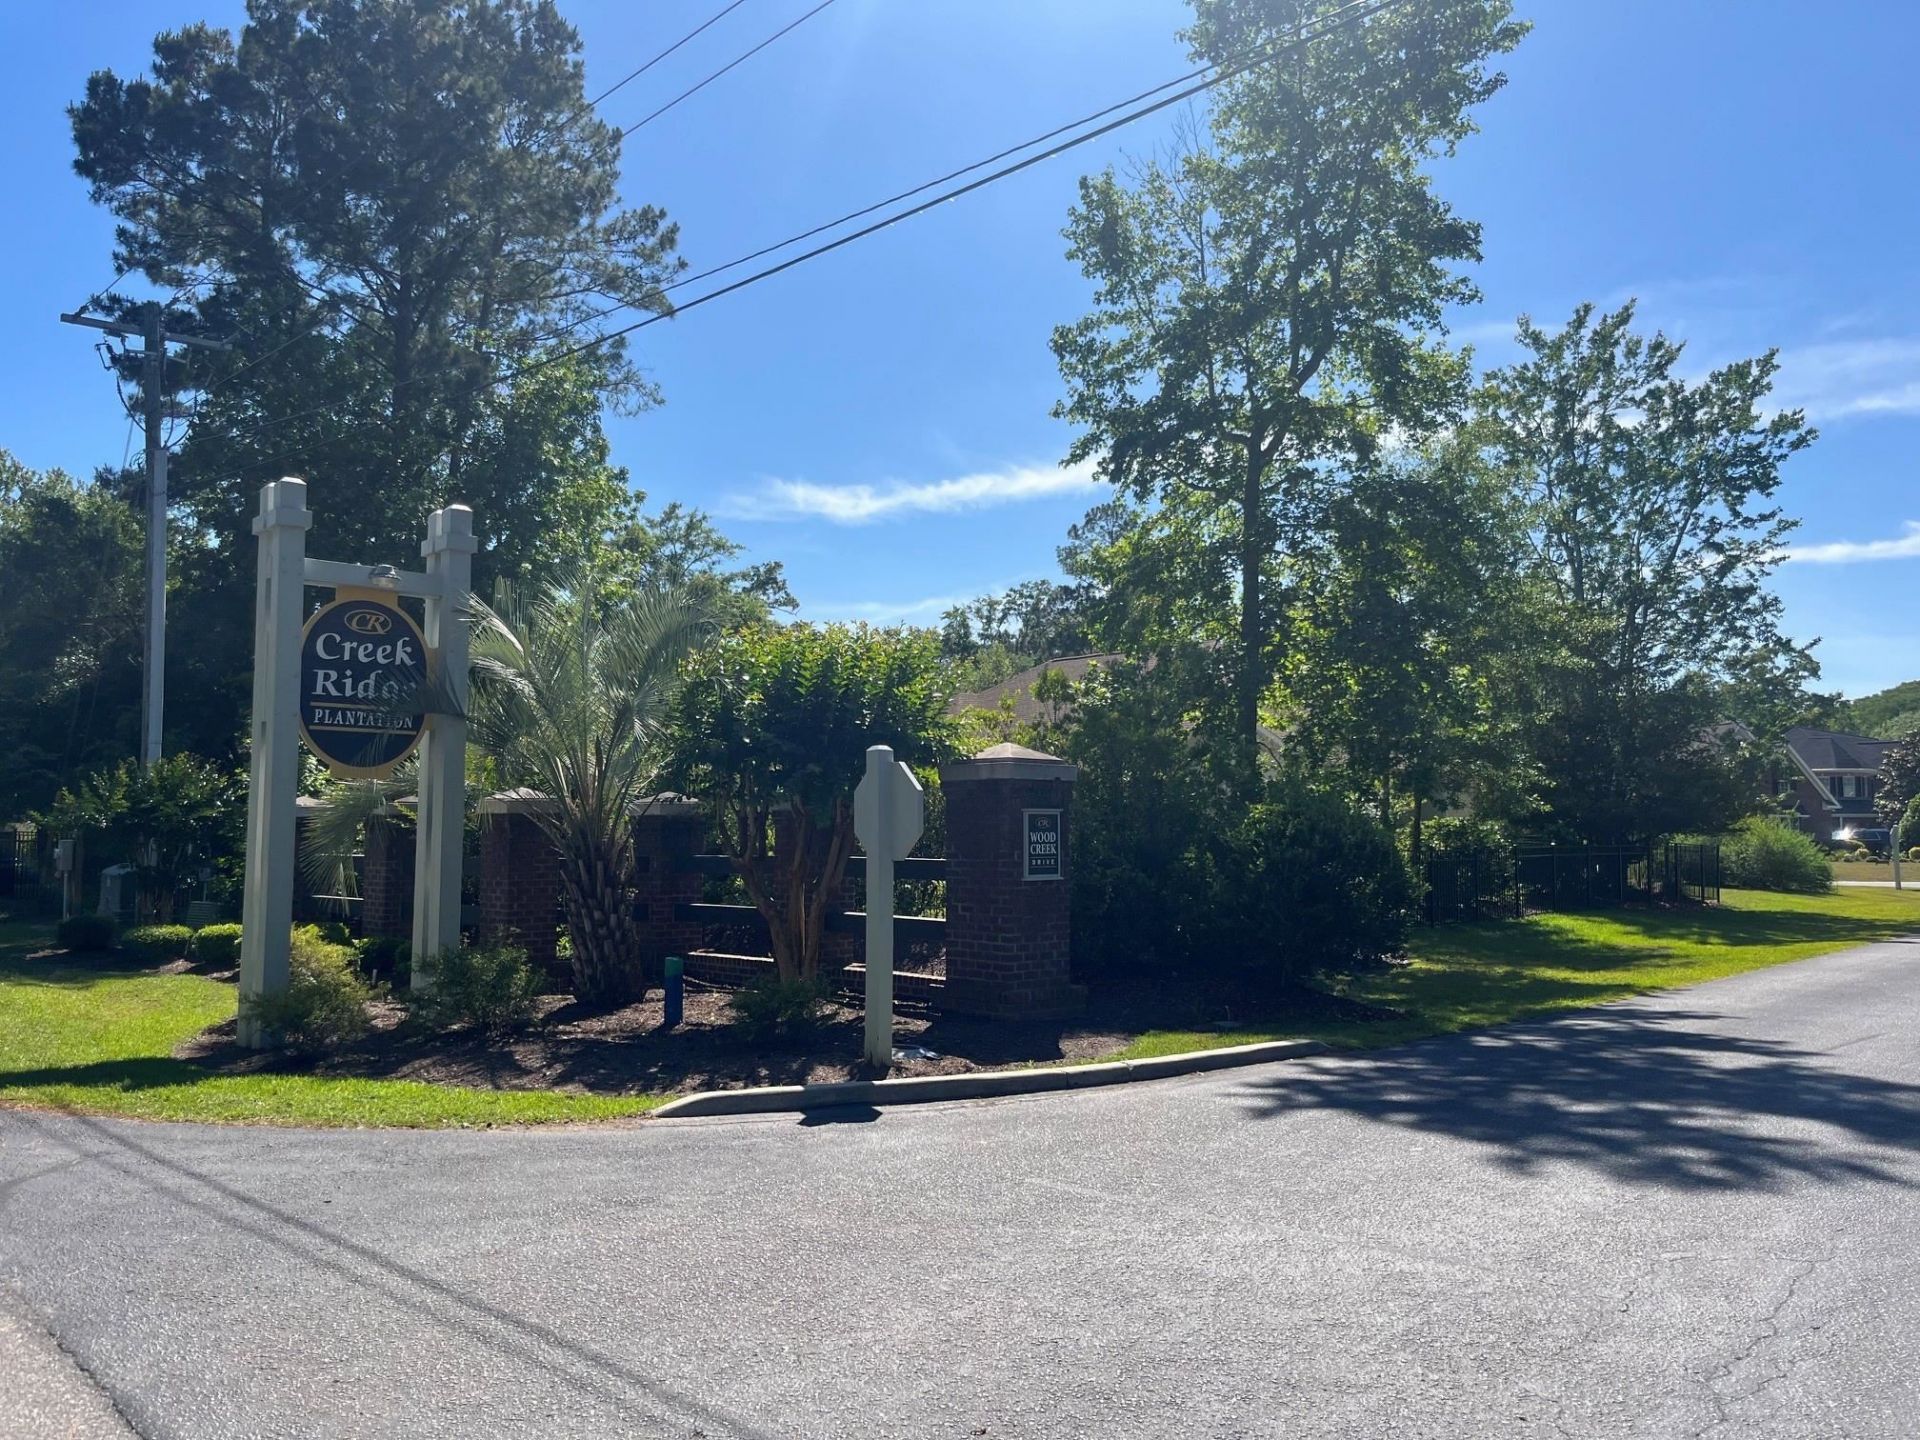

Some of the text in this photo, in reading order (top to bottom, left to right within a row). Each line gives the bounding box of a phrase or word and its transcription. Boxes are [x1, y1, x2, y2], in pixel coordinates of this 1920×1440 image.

[316, 632, 415, 667] Creek
[311, 668, 416, 711] Rid
[1030, 831, 1056, 843] WOOD
[1030, 843, 1057, 855] CREEK
